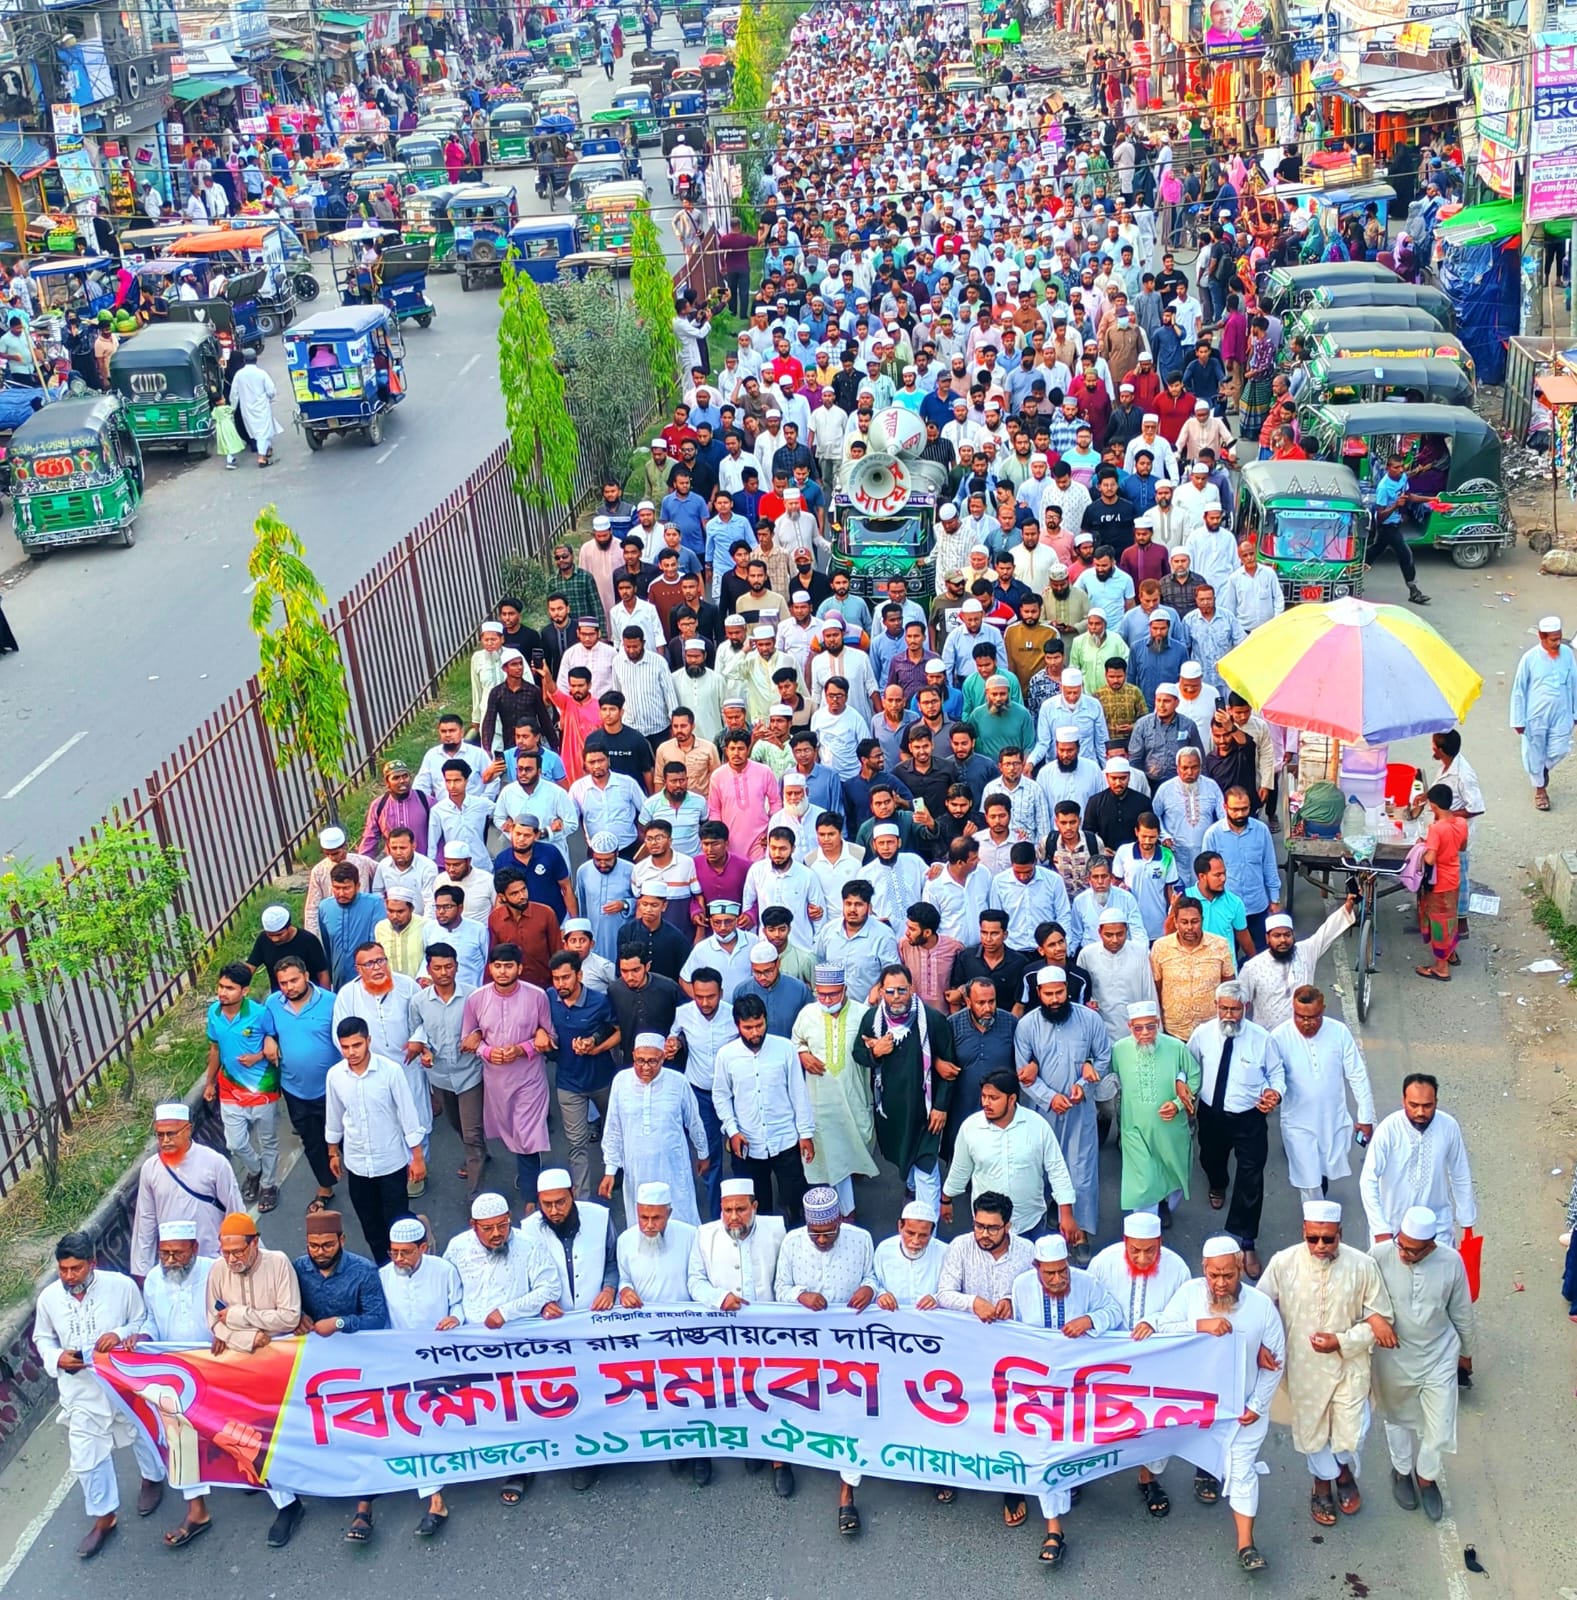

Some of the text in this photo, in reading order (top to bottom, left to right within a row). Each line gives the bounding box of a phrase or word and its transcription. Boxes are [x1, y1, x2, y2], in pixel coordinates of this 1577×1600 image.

[1538, 46, 1577, 73] IE
[415, 1338, 572, 1366] গণভোটের
[650, 1323, 818, 1349] বাস্তবায়নের
[834, 1324, 944, 1356] দাবিতে
[304, 1355, 1219, 1446] বিক্ষোভ সমাবেশ ও মিছিল
[574, 1432, 630, 1458] ১১
[640, 1420, 749, 1451] দলীয়
[761, 1418, 868, 1468] ঐক্য,
[880, 1443, 1030, 1486] নোয়াখালী
[1042, 1449, 1122, 1486] জেলা
